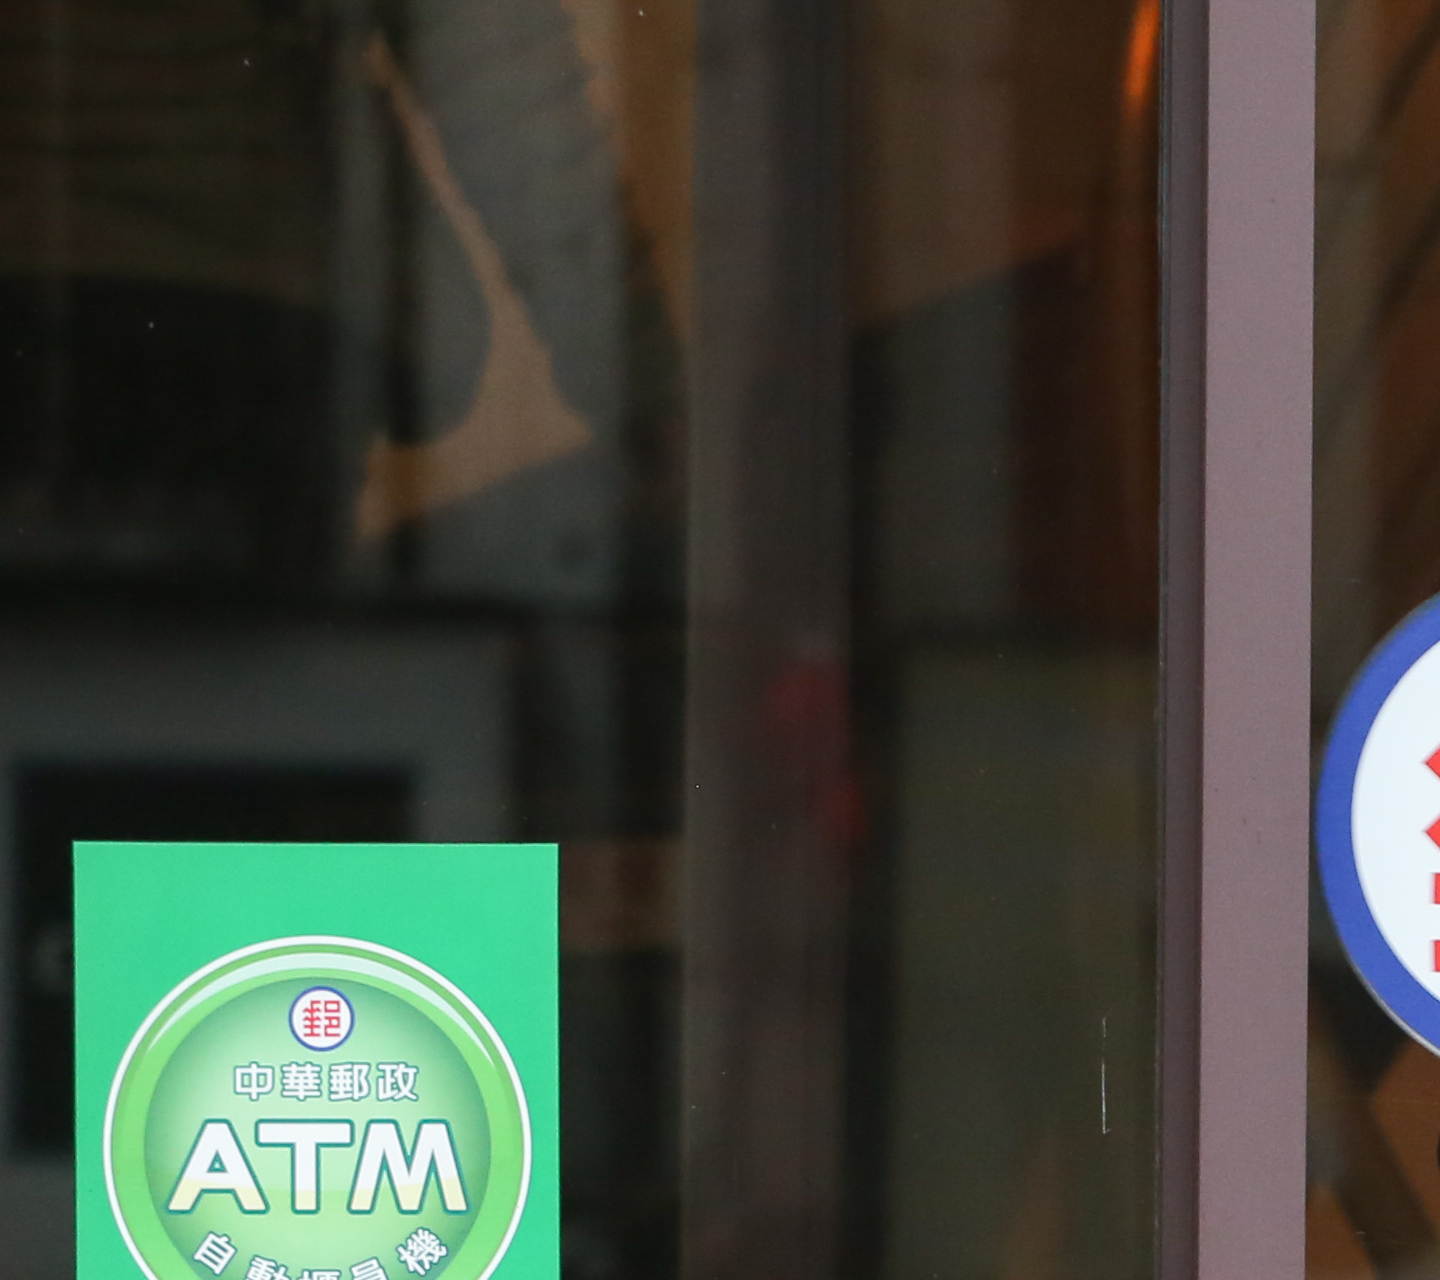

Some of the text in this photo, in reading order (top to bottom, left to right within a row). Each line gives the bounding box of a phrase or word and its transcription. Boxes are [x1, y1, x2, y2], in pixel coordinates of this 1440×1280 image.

[234, 1061, 419, 1103] 中華郵政
[166, 1118, 469, 1215] ATM
